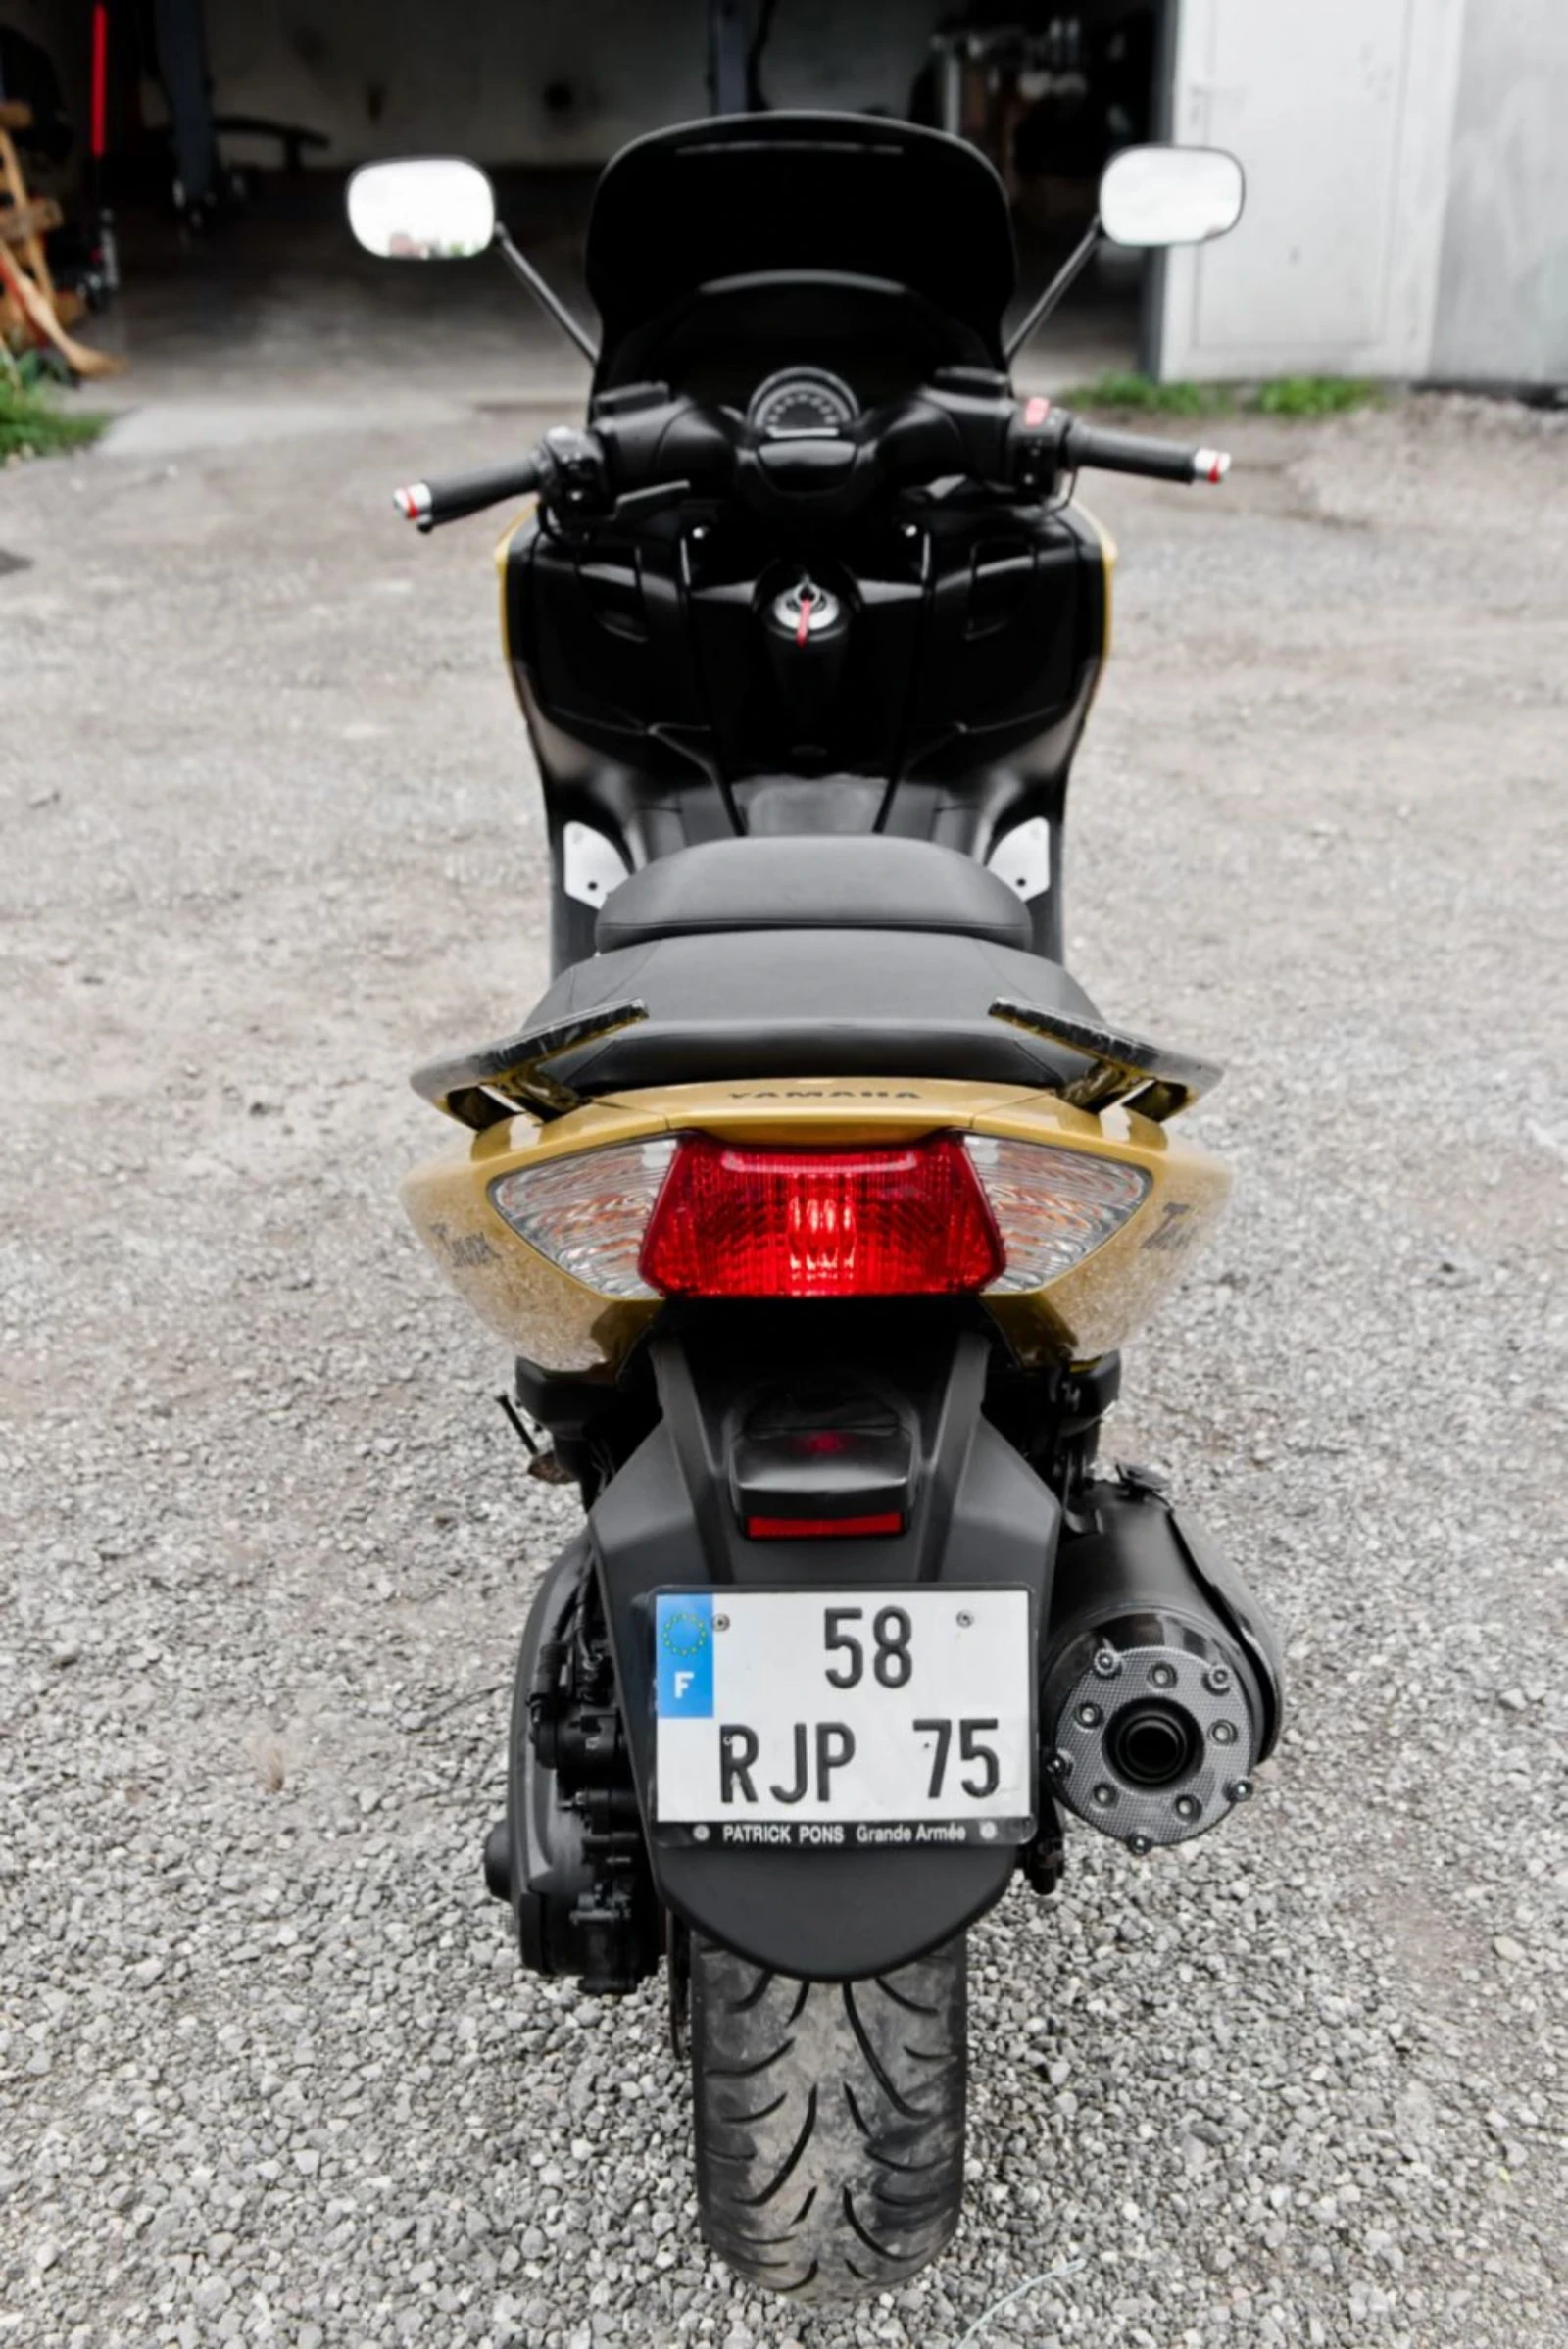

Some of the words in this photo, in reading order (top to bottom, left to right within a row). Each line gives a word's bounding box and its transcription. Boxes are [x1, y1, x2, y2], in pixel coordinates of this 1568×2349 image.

[729, 1090, 921, 1100] YAMAHA
[823, 1605, 913, 1689] 58
[673, 1671, 695, 1699] F
[718, 1721, 856, 1805] RJP
[911, 1718, 1000, 1799] 75
[722, 1824, 792, 1844] PATRICK
[799, 1824, 844, 1843] PONS
[856, 1823, 912, 1843] Grande
[915, 1821, 966, 1841] Armée
